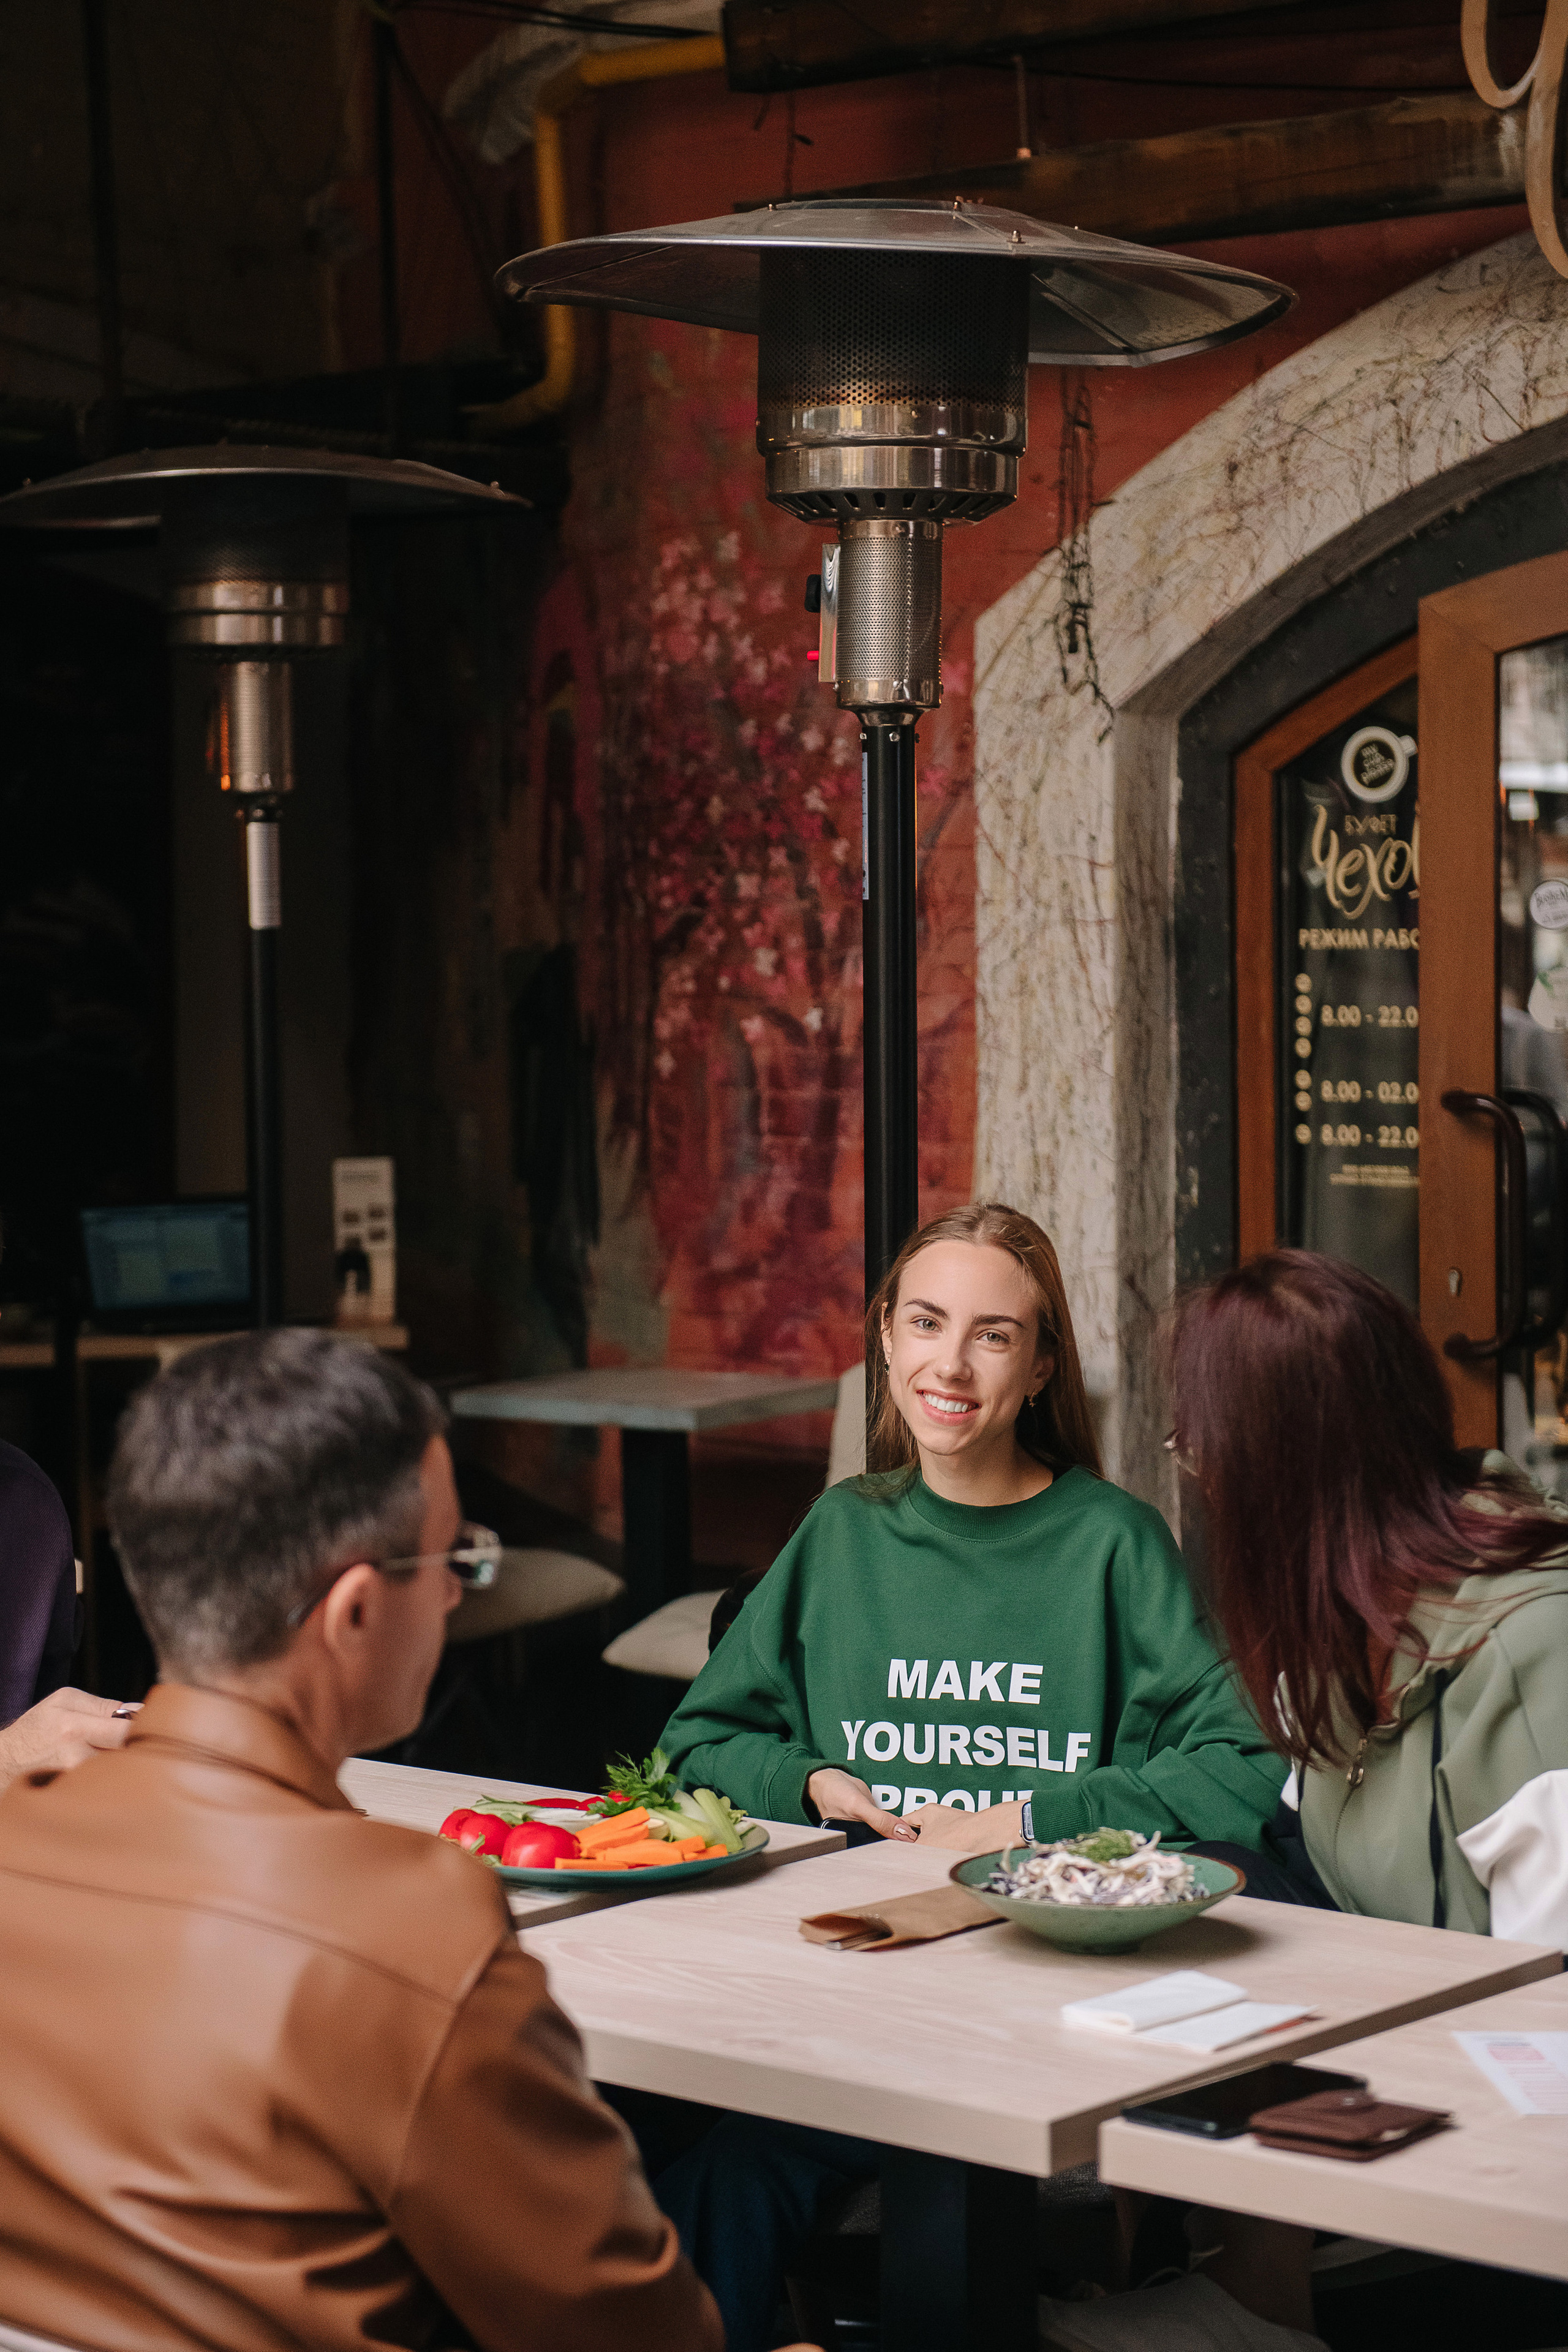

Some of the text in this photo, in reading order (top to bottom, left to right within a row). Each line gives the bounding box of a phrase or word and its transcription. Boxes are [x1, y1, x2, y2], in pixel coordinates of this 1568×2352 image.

[1298, 928, 1369, 949] РЕЖИМ
[887, 1658, 1044, 1705] MAKE
[840, 1719, 1091, 1773] YOURSELF
